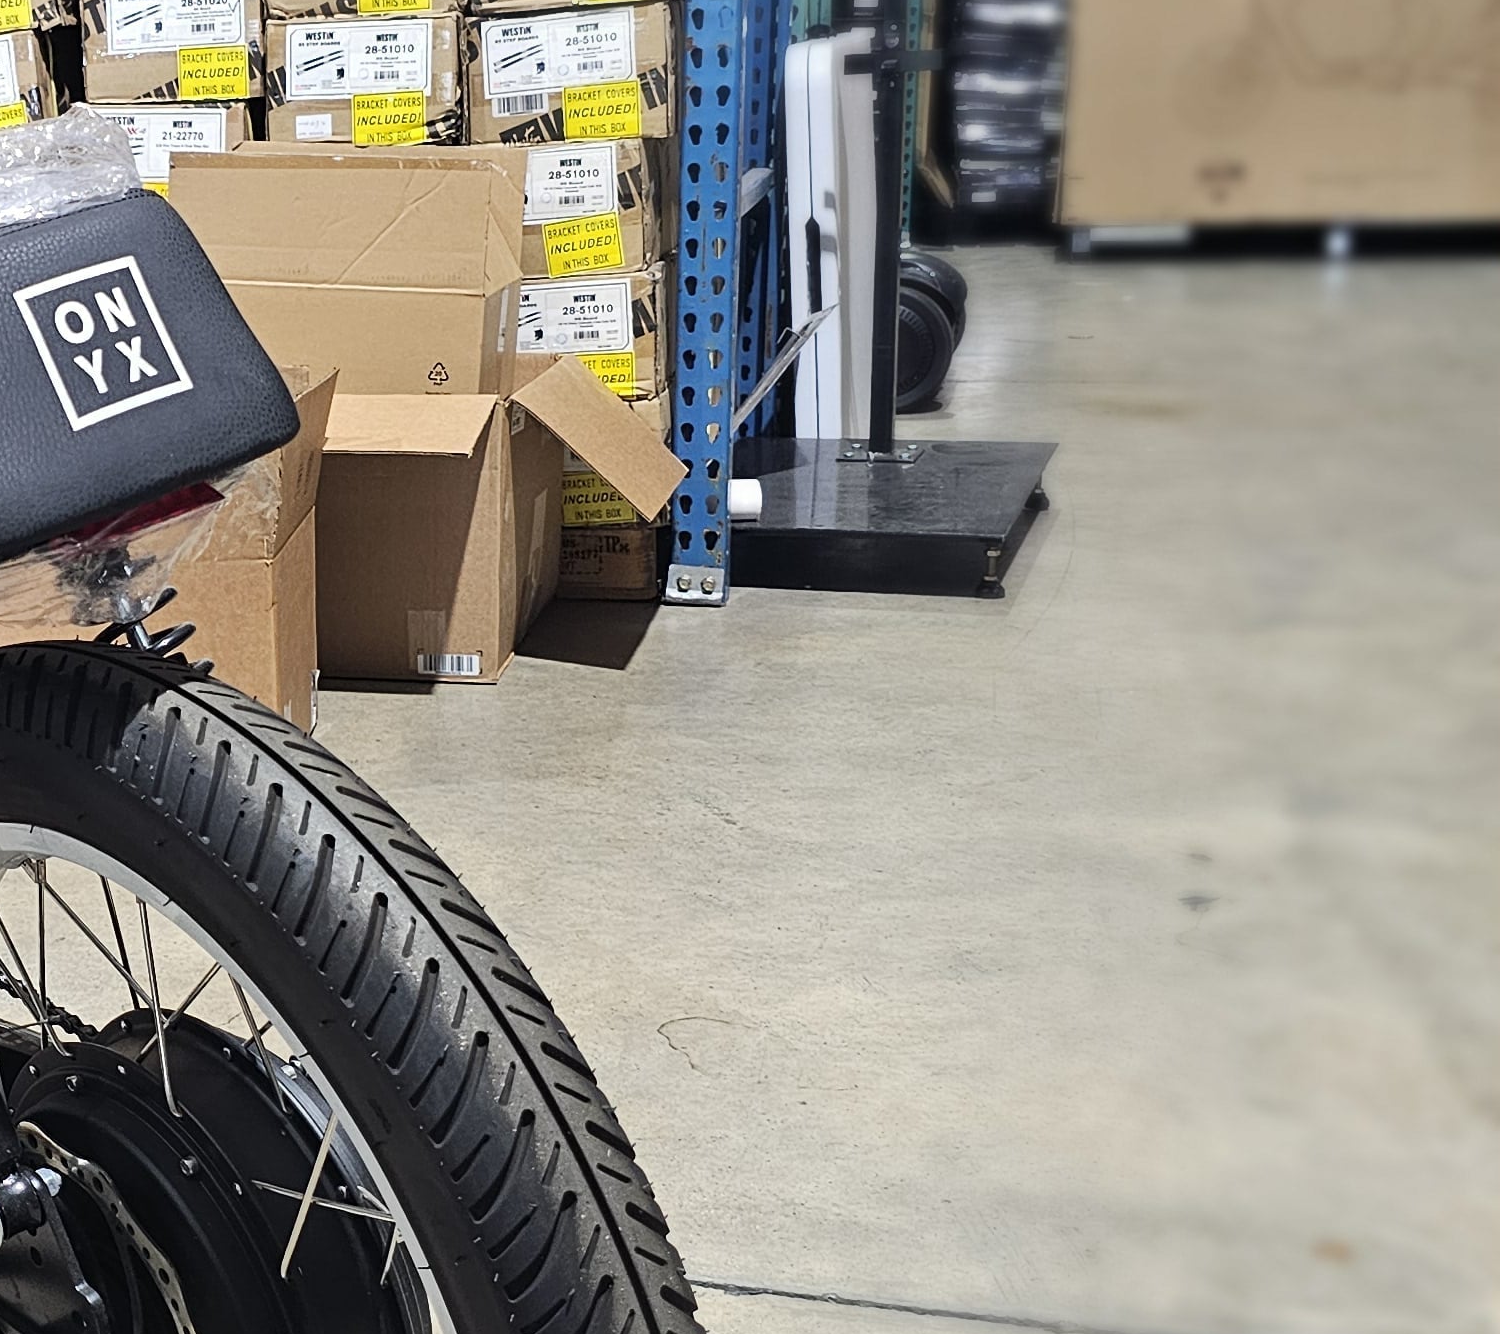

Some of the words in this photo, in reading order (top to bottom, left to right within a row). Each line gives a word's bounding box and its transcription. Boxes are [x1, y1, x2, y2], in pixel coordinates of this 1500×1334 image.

[5, 15, 20, 25] BOX
[305, 32, 334, 41] WESTIN
[501, 26, 532, 36] WESTIN
[376, 34, 398, 42] WESTIN
[565, 32, 617, 47] 28-51010
[364, 45, 415, 55] 28-51010
[182, 53, 213, 64] BRACKET
[216, 51, 244, 62] COVERS
[182, 66, 244, 80] INCLUDED!
[192, 86, 201, 95] IN
[201, 85, 218, 95] THIS
[221, 84, 236, 94] BOX
[567, 89, 601, 103] BRACKET
[606, 86, 636, 99] COVERS
[356, 99, 389, 110] BRACKET
[393, 97, 421, 107] COVERS
[568, 102, 637, 119] INCLUDED!
[356, 112, 421, 126] INCLUDED!
[579, 125, 588, 135] IN
[588, 124, 607, 134] THIS
[610, 122, 626, 132] BOX
[162, 131, 204, 141] 21-22770
[367, 133, 375, 142] IN
[375, 132, 393, 142] THIS
[560, 158, 582, 167] WESTIN
[548, 169, 600, 180] 28-51010
[547, 226, 581, 240] BRACKET
[585, 219, 615, 232] COVERS
[550, 235, 617, 255] INCLUDED!
[563, 260, 571, 270] IN
[571, 257, 590, 268] THIS
[593, 253, 610, 265] BOX
[573, 294, 596, 303] WESTIN
[562, 304, 614, 316] 28-51010
[601, 358, 630, 369] COVERS
[575, 511, 582, 520] IN
[583, 509, 603, 519] THIS
[605, 508, 622, 518] BOX
